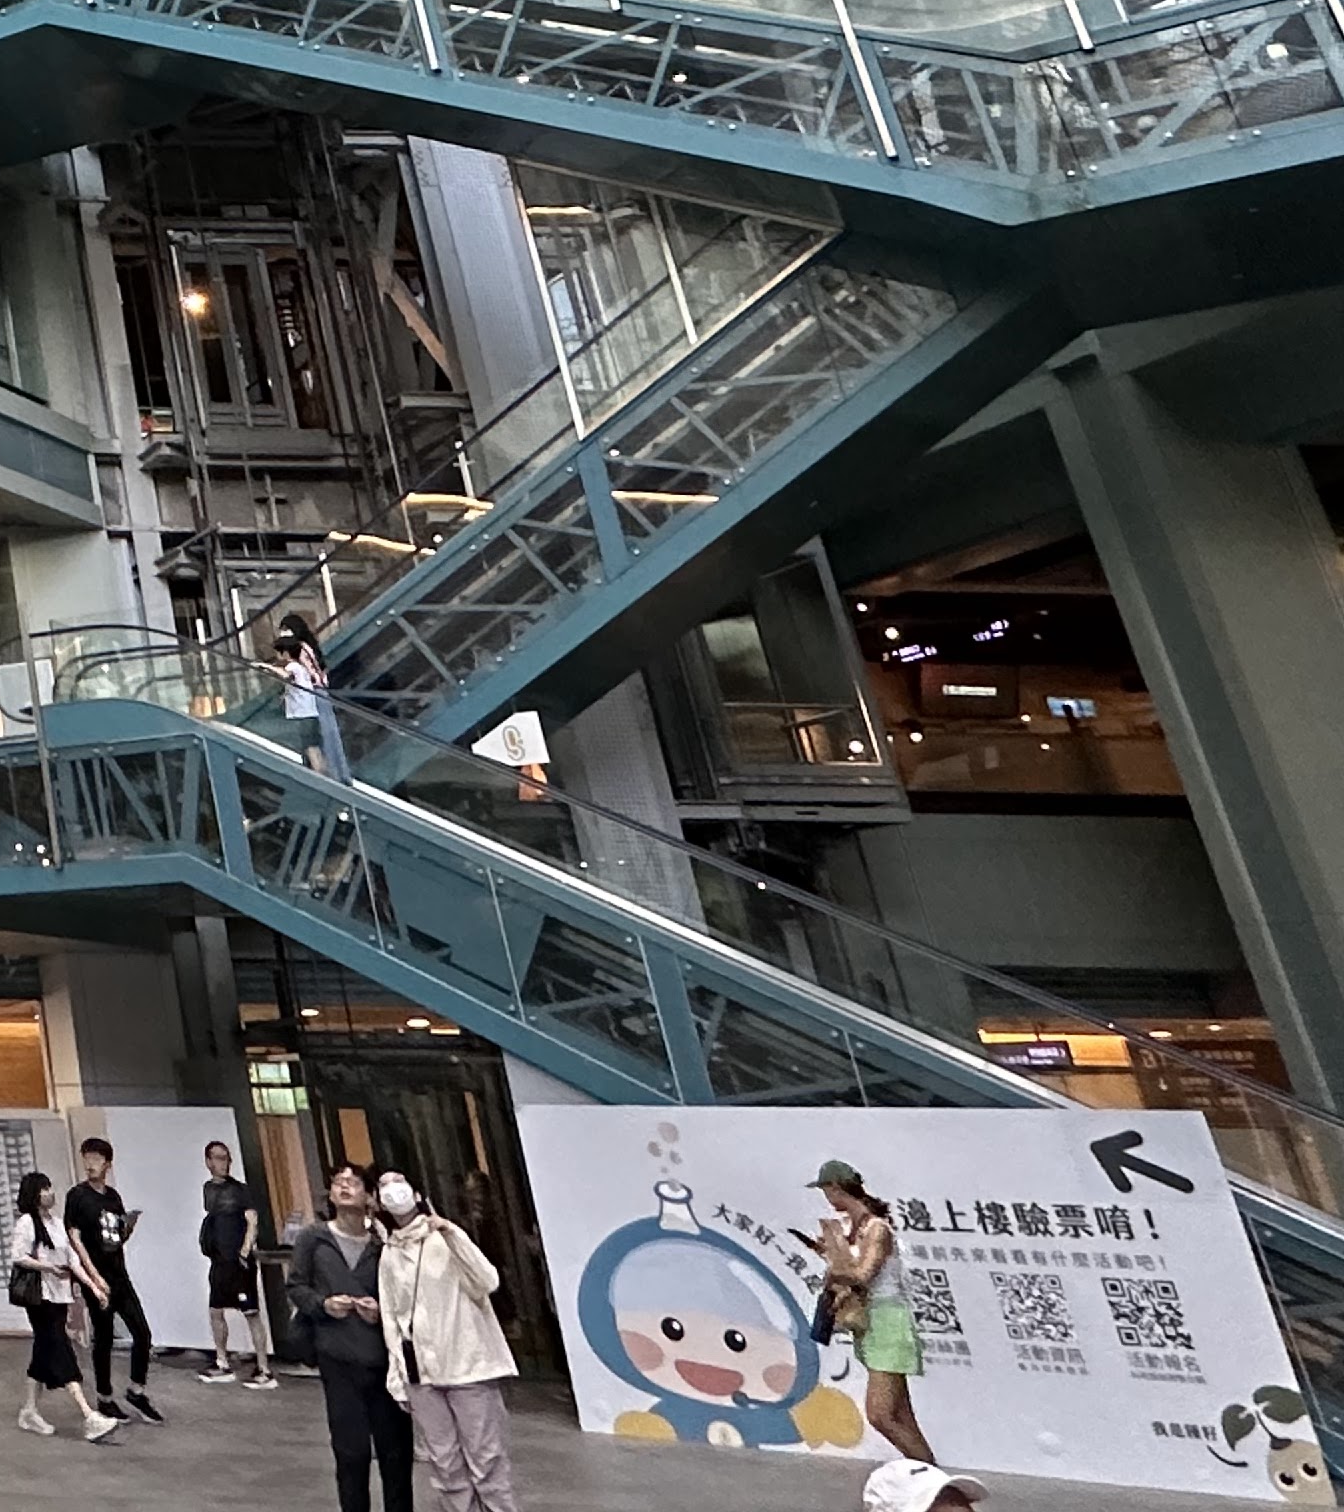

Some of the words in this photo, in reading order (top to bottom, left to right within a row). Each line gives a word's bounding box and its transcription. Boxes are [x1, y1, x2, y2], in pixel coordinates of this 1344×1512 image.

[891, 1198, 1161, 1240] 邊上樓驗票唷！
